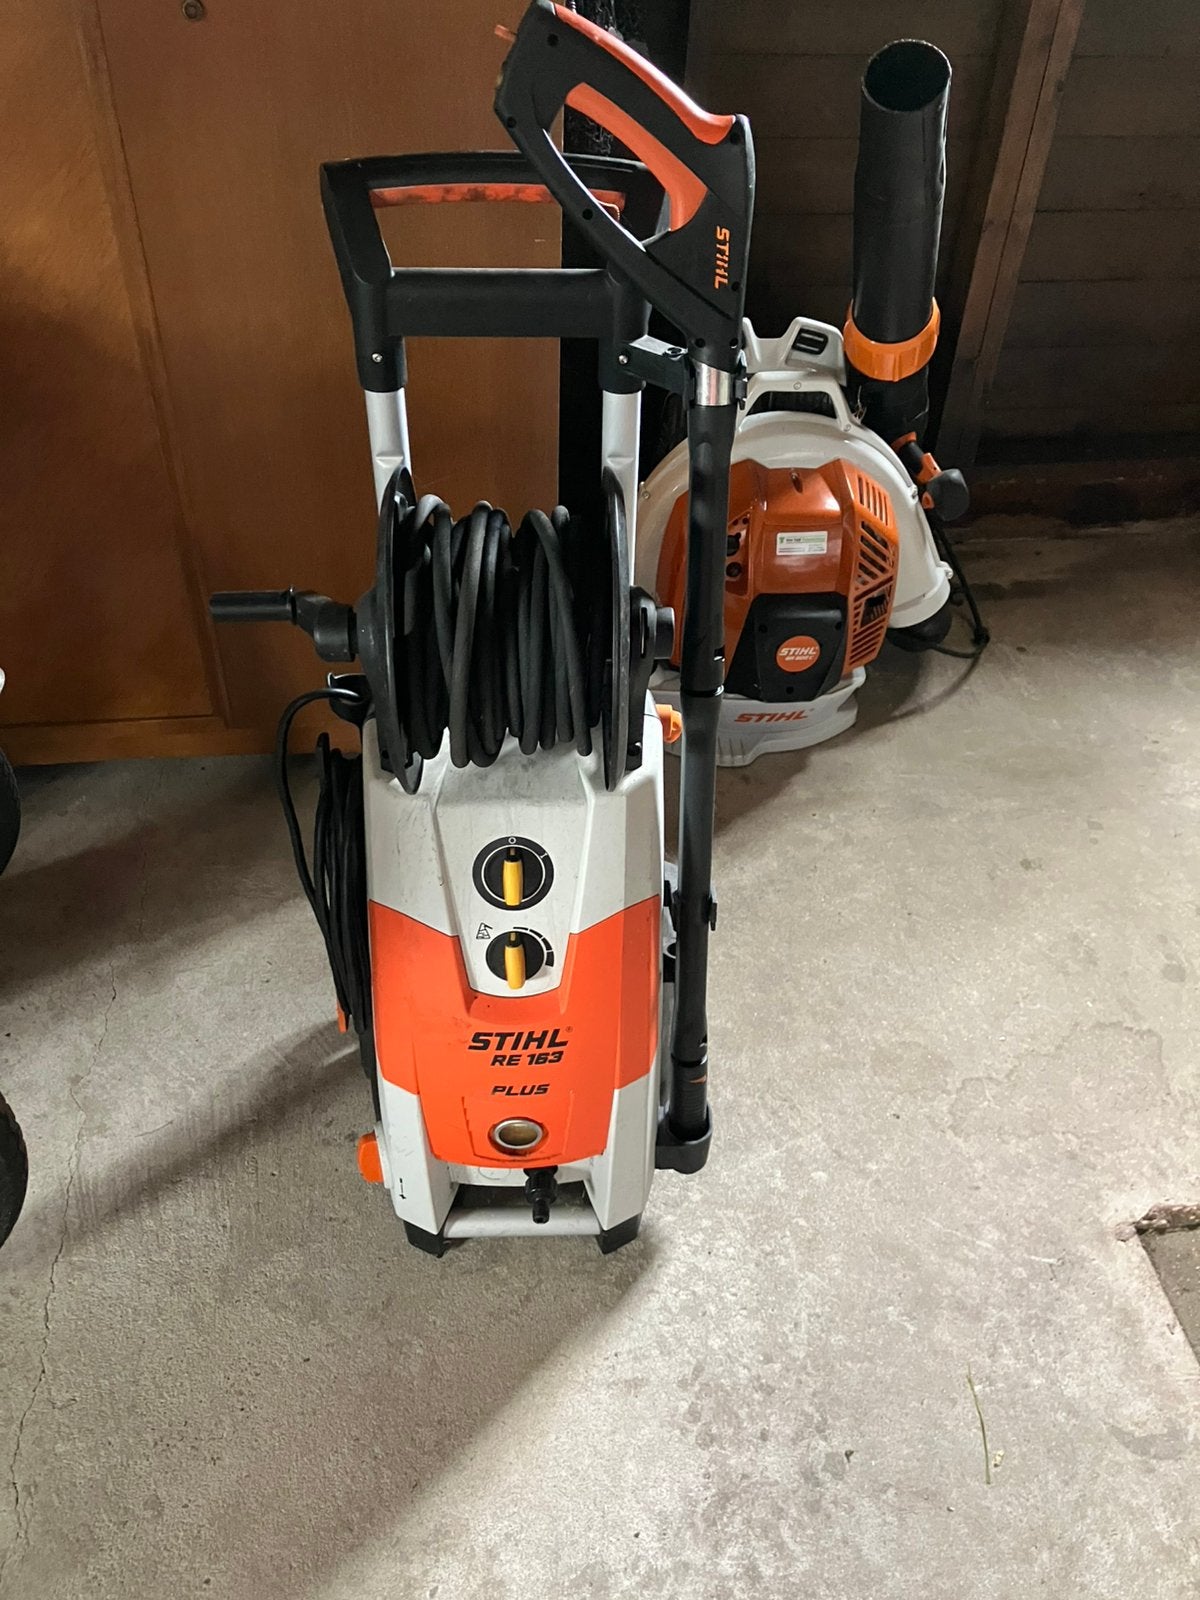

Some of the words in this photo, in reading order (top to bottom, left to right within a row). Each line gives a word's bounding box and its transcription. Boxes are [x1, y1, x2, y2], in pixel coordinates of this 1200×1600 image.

[715, 225, 730, 289] STIHL
[779, 646, 817, 656] STIHL
[734, 709, 808, 723] STIHL
[467, 1029, 569, 1051] STIHL
[490, 1054, 522, 1066] RE
[527, 1050, 564, 1066] 163
[491, 1084, 550, 1096] PLUS
